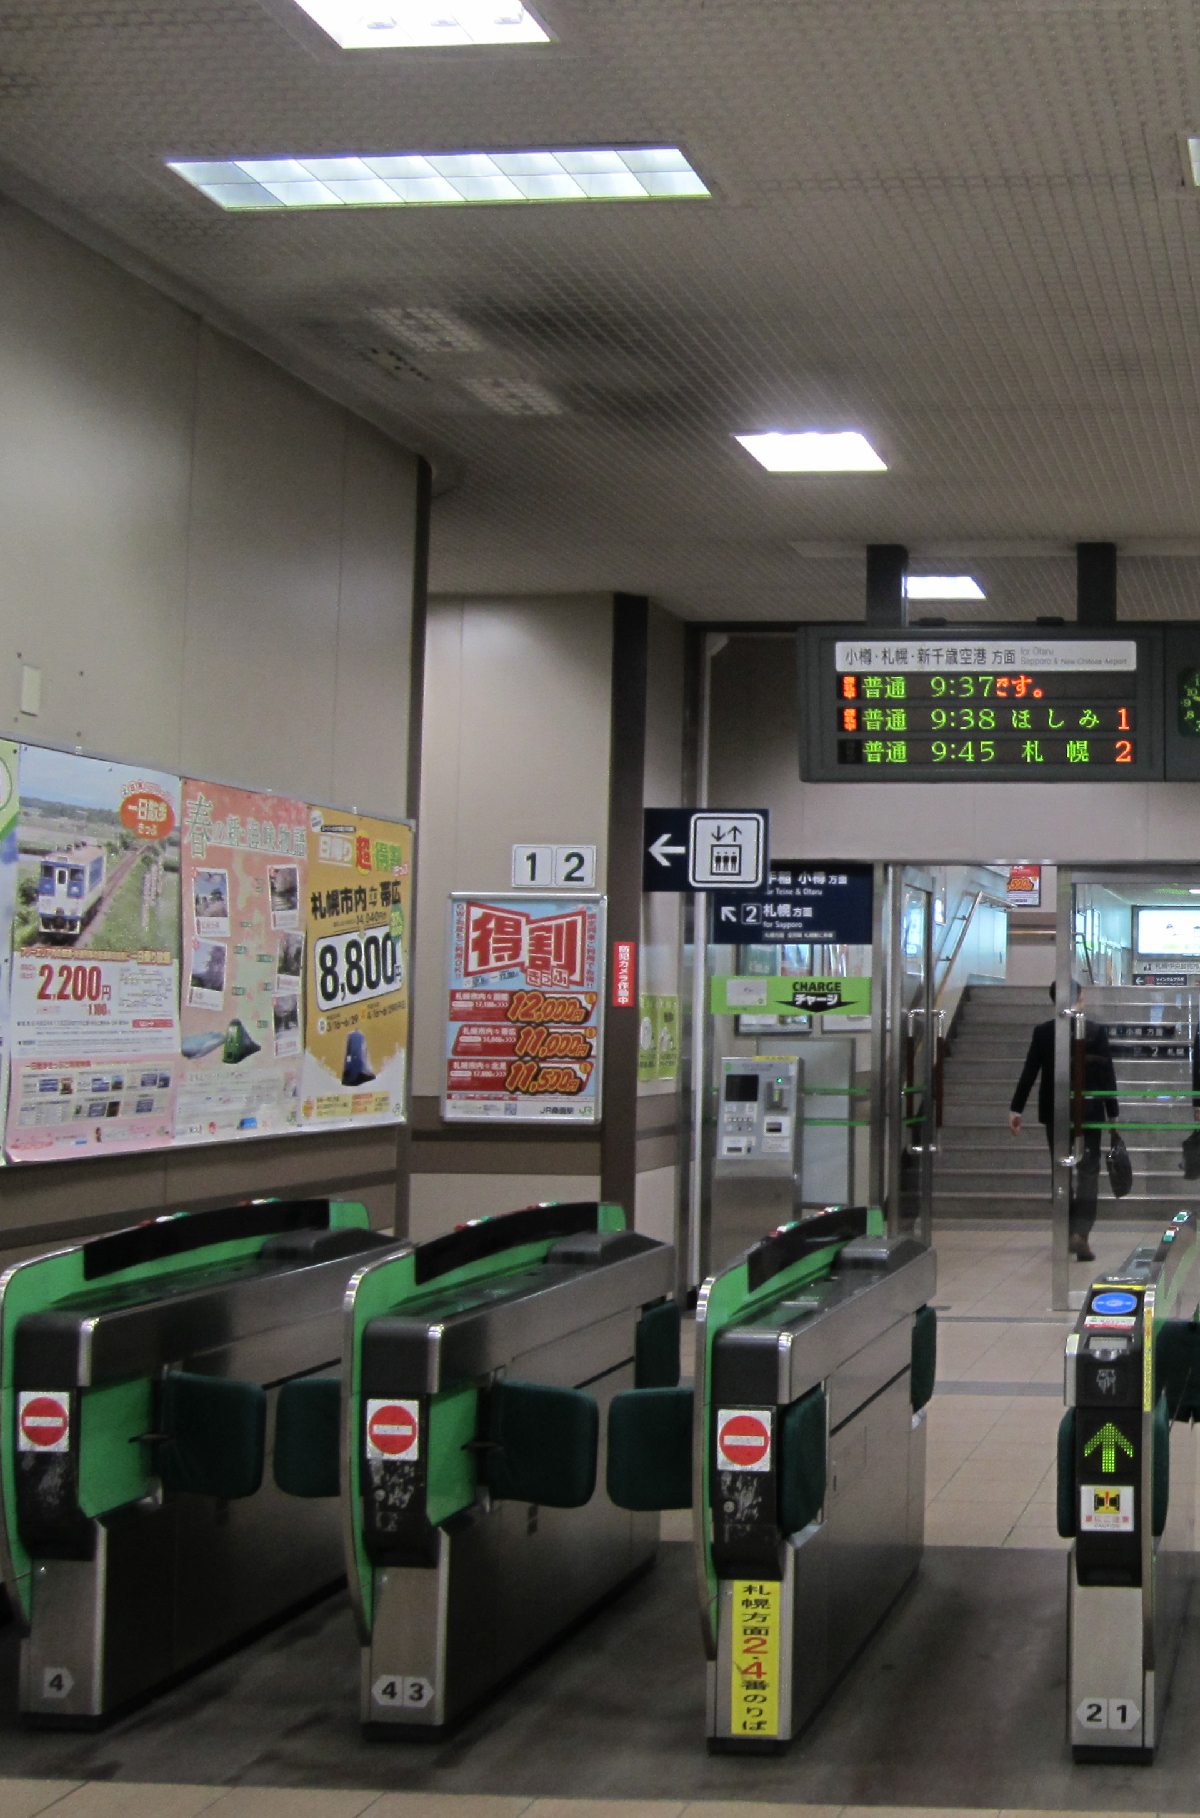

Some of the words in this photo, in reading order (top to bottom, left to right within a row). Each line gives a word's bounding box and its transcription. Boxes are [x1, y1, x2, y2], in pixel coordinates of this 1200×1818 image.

[862, 676, 907, 699] 普通
[930, 676, 994, 698] 9:37
[862, 708, 907, 731] 普通
[930, 708, 996, 731] 9:38
[1117, 708, 1130, 730] 1
[862, 740, 908, 763] 普通
[931, 740, 996, 763] 9:45
[1115, 740, 1133, 762] 2
[525, 852, 537, 881] 1
[563, 851, 585, 882] 2
[745, 906, 757, 923] 2
[471, 911, 578, 978] 得割
[792, 982, 842, 992] CHARGE
[794, 994, 838, 1005] チャージ
[49, 1674, 64, 1692] 4
[381, 1682, 397, 1699] 4
[409, 1683, 424, 1700] 3
[1086, 1703, 1103, 1722] 2
[1116, 1704, 1128, 1723] 1
